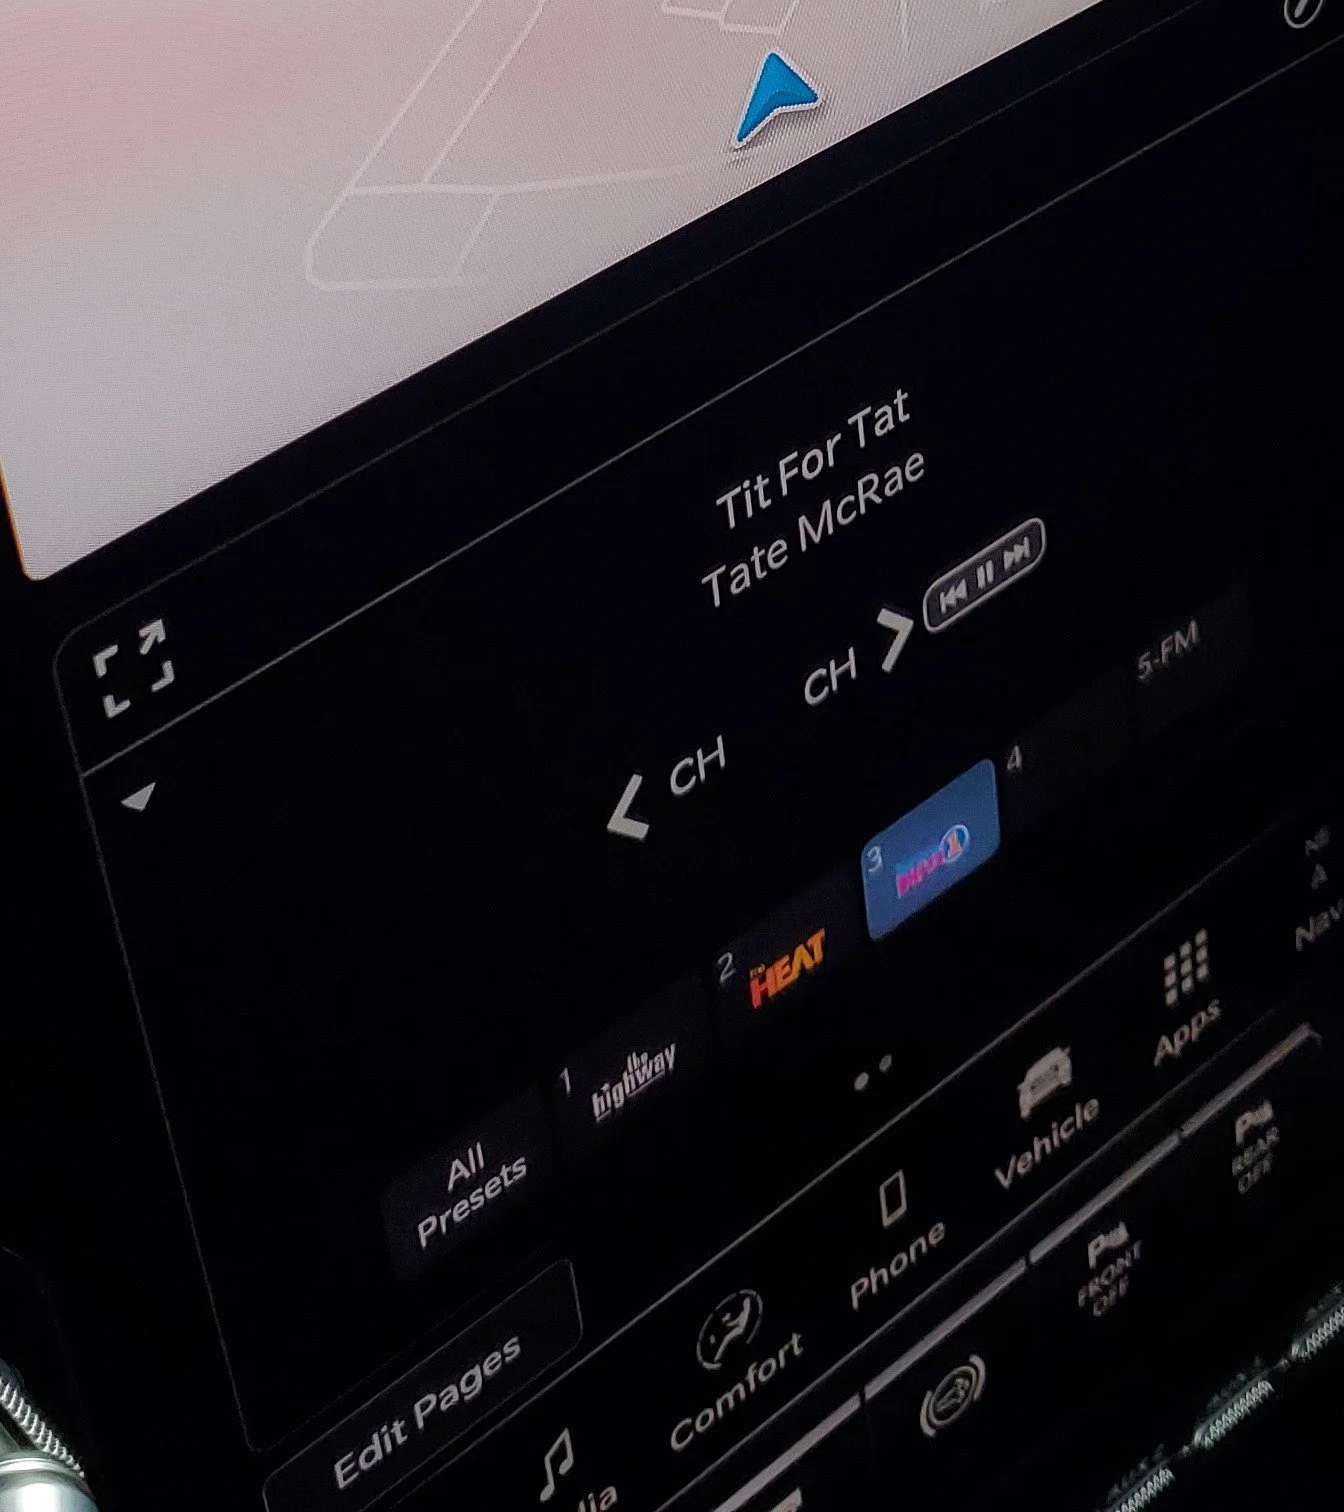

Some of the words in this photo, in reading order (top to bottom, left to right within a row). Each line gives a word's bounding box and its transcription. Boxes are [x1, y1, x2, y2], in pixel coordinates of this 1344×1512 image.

[716, 475, 772, 529] Tit
[779, 433, 842, 497] For
[848, 389, 911, 449] Tat
[701, 540, 789, 608] Tate
[798, 452, 926, 553] McRae
[804, 647, 857, 706] CH
[1137, 619, 1199, 681] 5-FM
[669, 735, 726, 797] CH
[867, 845, 883, 873] 3
[717, 951, 736, 984] 2
[749, 927, 826, 1009] HEAT
[1154, 1000, 1222, 1067] Apps
[559, 1067, 572, 1097] 1
[591, 1042, 676, 1120] highway
[447, 1142, 485, 1191] All
[994, 1098, 1101, 1189] Vehicle
[418, 1156, 527, 1249] Presets
[851, 1219, 947, 1310] Phone
[333, 1419, 409, 1489] Edit
[413, 1335, 522, 1429] Pages
[670, 1333, 804, 1451] Comfort
